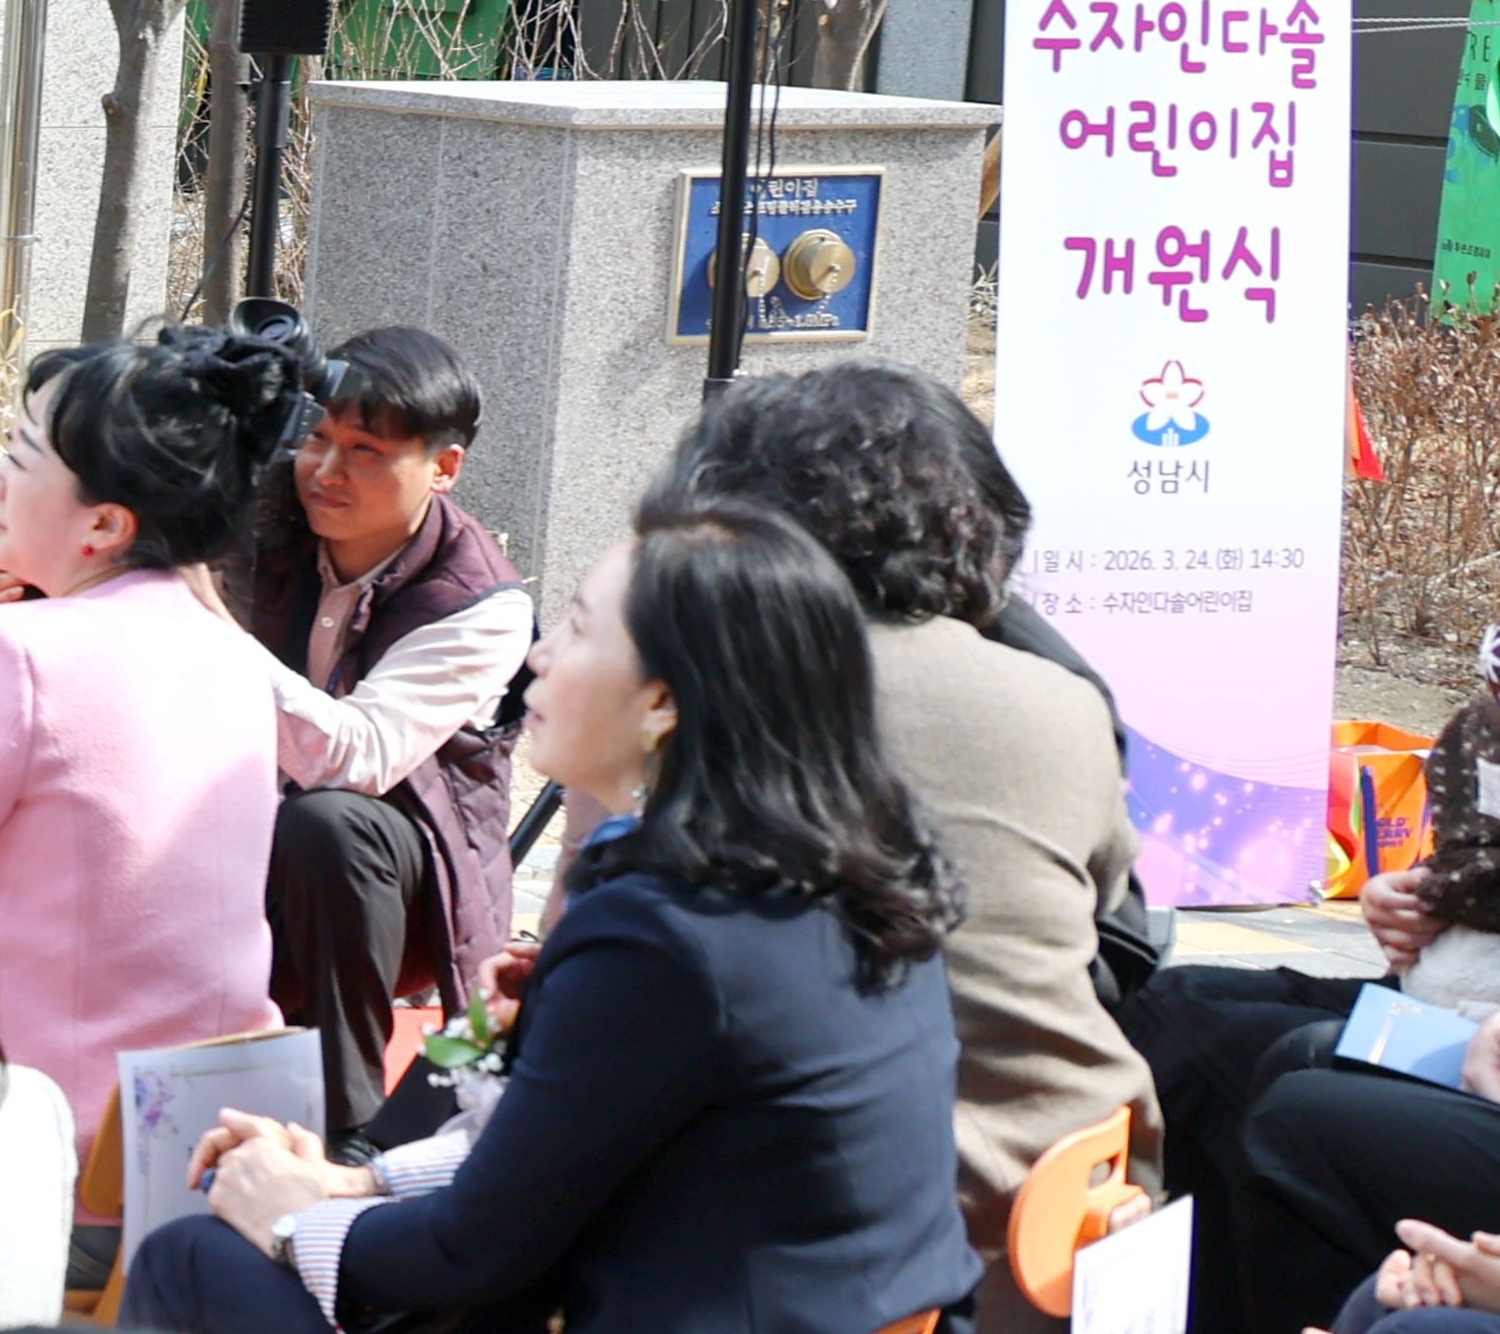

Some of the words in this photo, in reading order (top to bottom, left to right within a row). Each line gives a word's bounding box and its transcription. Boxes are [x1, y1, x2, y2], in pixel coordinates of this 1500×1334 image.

[1061, 101, 1295, 188] 어린이집
[1065, 225, 1279, 323] 개원식
[1127, 460, 1210, 495] 성남시
[1104, 550, 1156, 571] 2026.
[1250, 548, 1305, 570] 14:30
[1102, 590, 1253, 614] 수자인다솔어린이집
